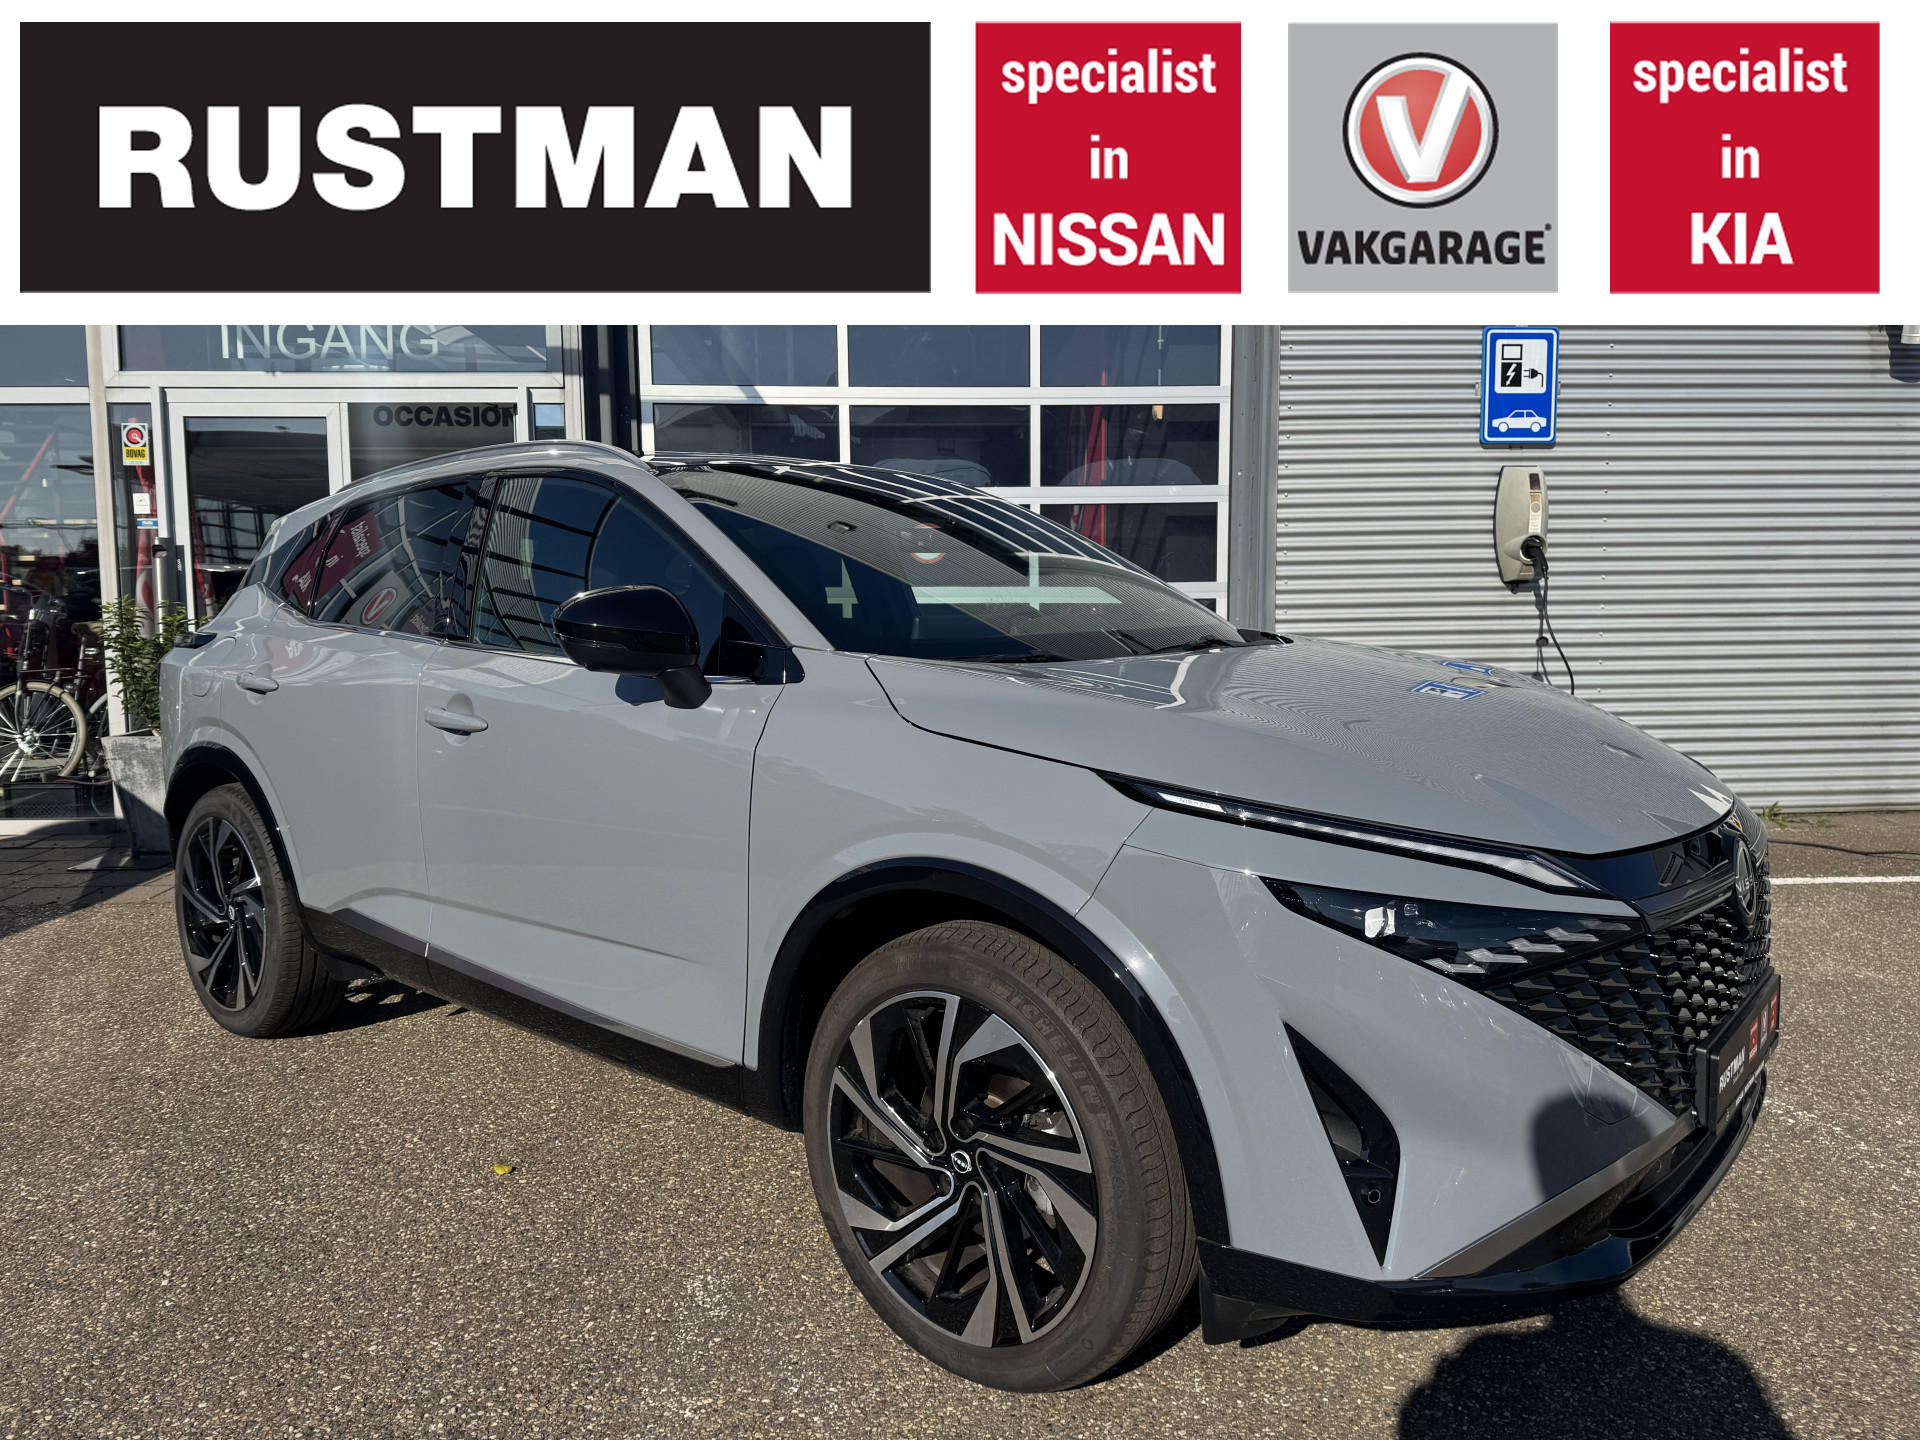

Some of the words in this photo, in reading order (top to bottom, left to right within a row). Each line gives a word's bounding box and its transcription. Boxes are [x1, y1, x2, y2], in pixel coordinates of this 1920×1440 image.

[221, 325, 438, 360] INGANG
[372, 405, 514, 427] OCCASION
[125, 448, 146, 459] BOVAG
